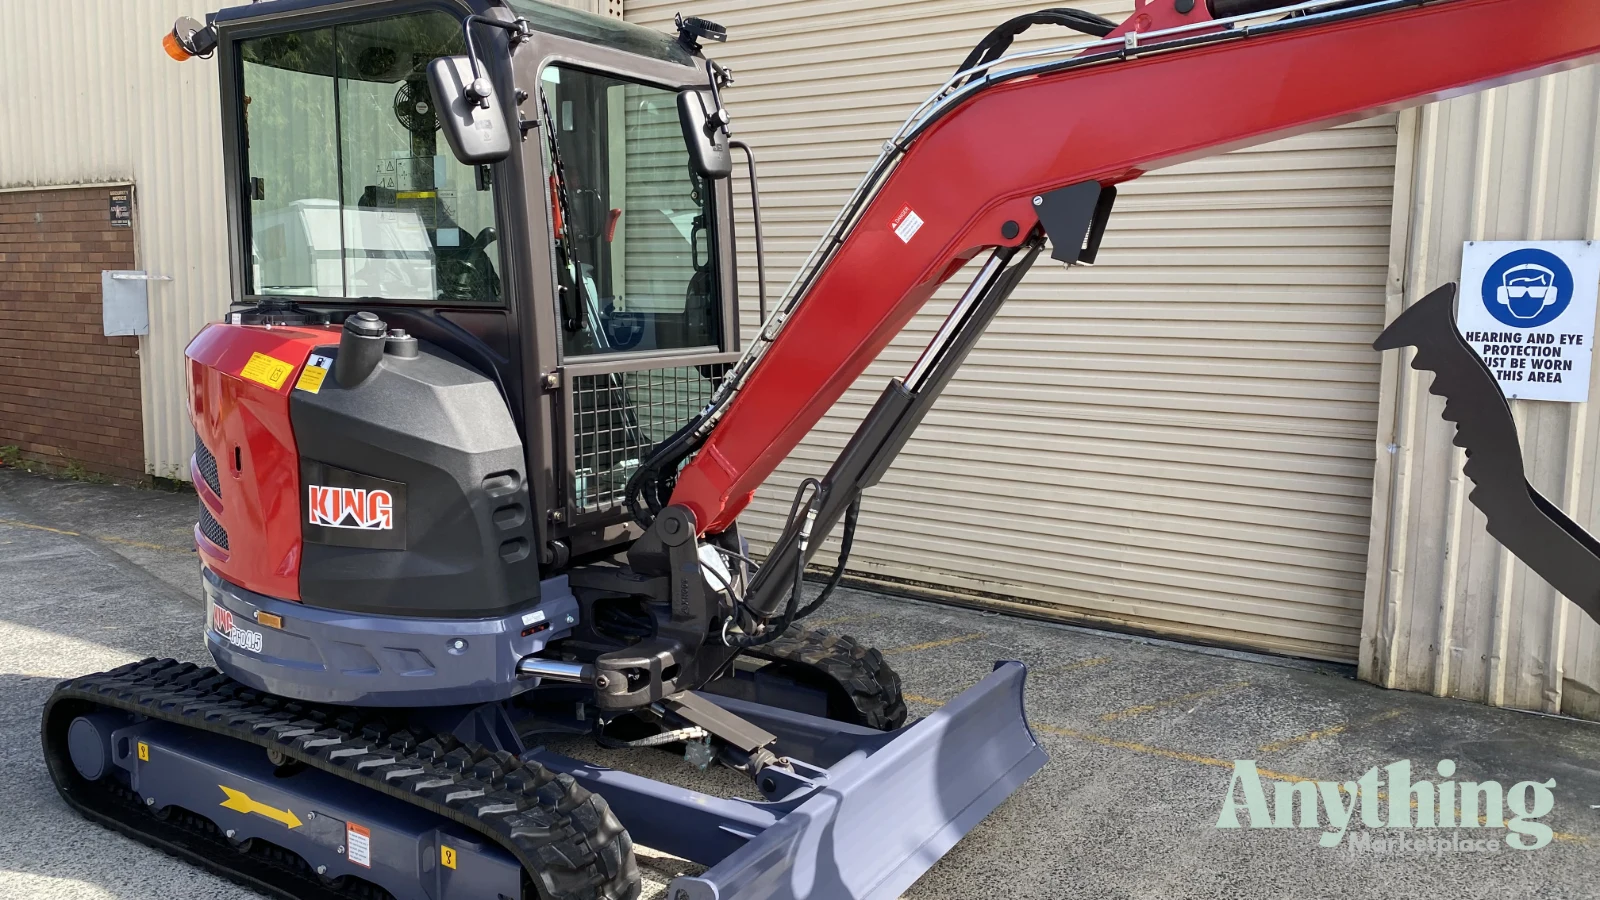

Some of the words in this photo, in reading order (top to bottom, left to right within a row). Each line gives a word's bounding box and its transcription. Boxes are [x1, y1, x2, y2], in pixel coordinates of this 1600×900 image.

[895, 206, 910, 223] DANGER
[1466, 332, 1522, 343] HEARING
[1527, 333, 1555, 344] AND
[1560, 334, 1583, 345] EYE
[1483, 345, 1562, 357] PROTECTION
[1484, 357, 1506, 368] UST
[1510, 358, 1526, 369] BE
[1531, 359, 1572, 370] WORN
[1497, 370, 1523, 381] THIS
[1528, 372, 1562, 383] AREA
[309, 485, 392, 530] KING
[213, 603, 233, 640] KING
